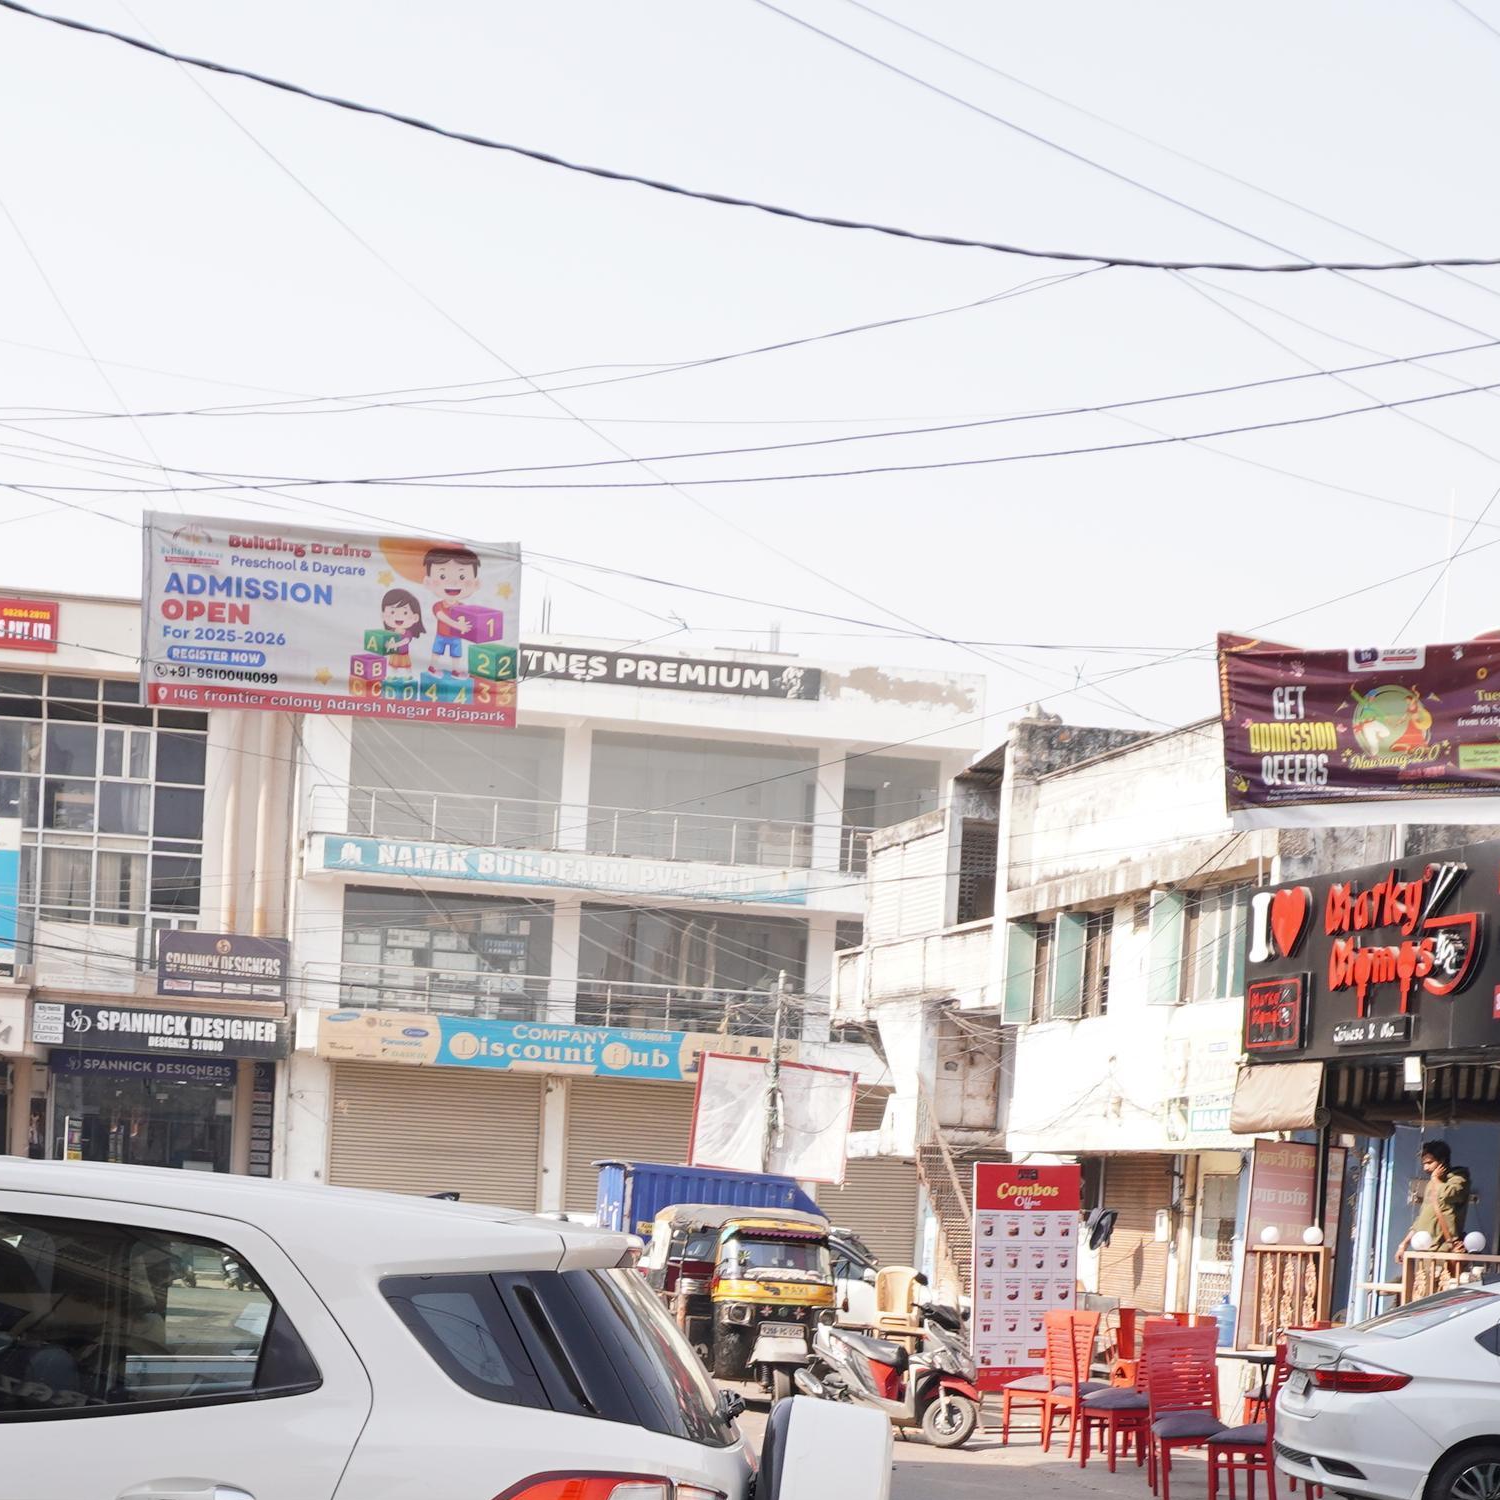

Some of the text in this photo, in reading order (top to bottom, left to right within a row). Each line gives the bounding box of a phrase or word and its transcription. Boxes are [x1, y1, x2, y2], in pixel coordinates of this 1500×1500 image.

[228, 534, 373, 560] Building Brains
[230, 555, 298, 573] Preschool
[299, 558, 310, 572] &
[312, 560, 367, 577] Daycare
[164, 571, 334, 606] ADMISSION
[161, 598, 251, 625] OPEN
[162, 625, 287, 647] For 2025-2026
[172, 647, 262, 664] REGISTER NOW
[169, 664, 279, 685] +91-9610044099
[615, 657, 770, 691] PREMIUM
[172, 687, 506, 724] 146 frontier colony Adarsh Nagar Rajapark
[1272, 685, 1307, 721] GET
[1470, 704, 1492, 715] 30th
[1457, 718, 1480, 728] from
[1249, 721, 1338, 754] ADMISSION
[1261, 753, 1329, 787] OFFERS
[377, 843, 468, 872] NANAK
[478, 851, 630, 888] BUILDFARM
[1249, 891, 1273, 963] I
[165, 951, 282, 979] SPANNICK DESIGNERS
[96, 1010, 278, 1043] SPANNICK DESIGNER
[512, 1023, 610, 1046] COMPANY
[147, 1035, 225, 1053] DESIGNER STUDIO
[454, 1032, 670, 1070] Discount Hub
[83, 1058, 232, 1078] SPANNICK DESIGNERS
[996, 1182, 1060, 1200] Combos
